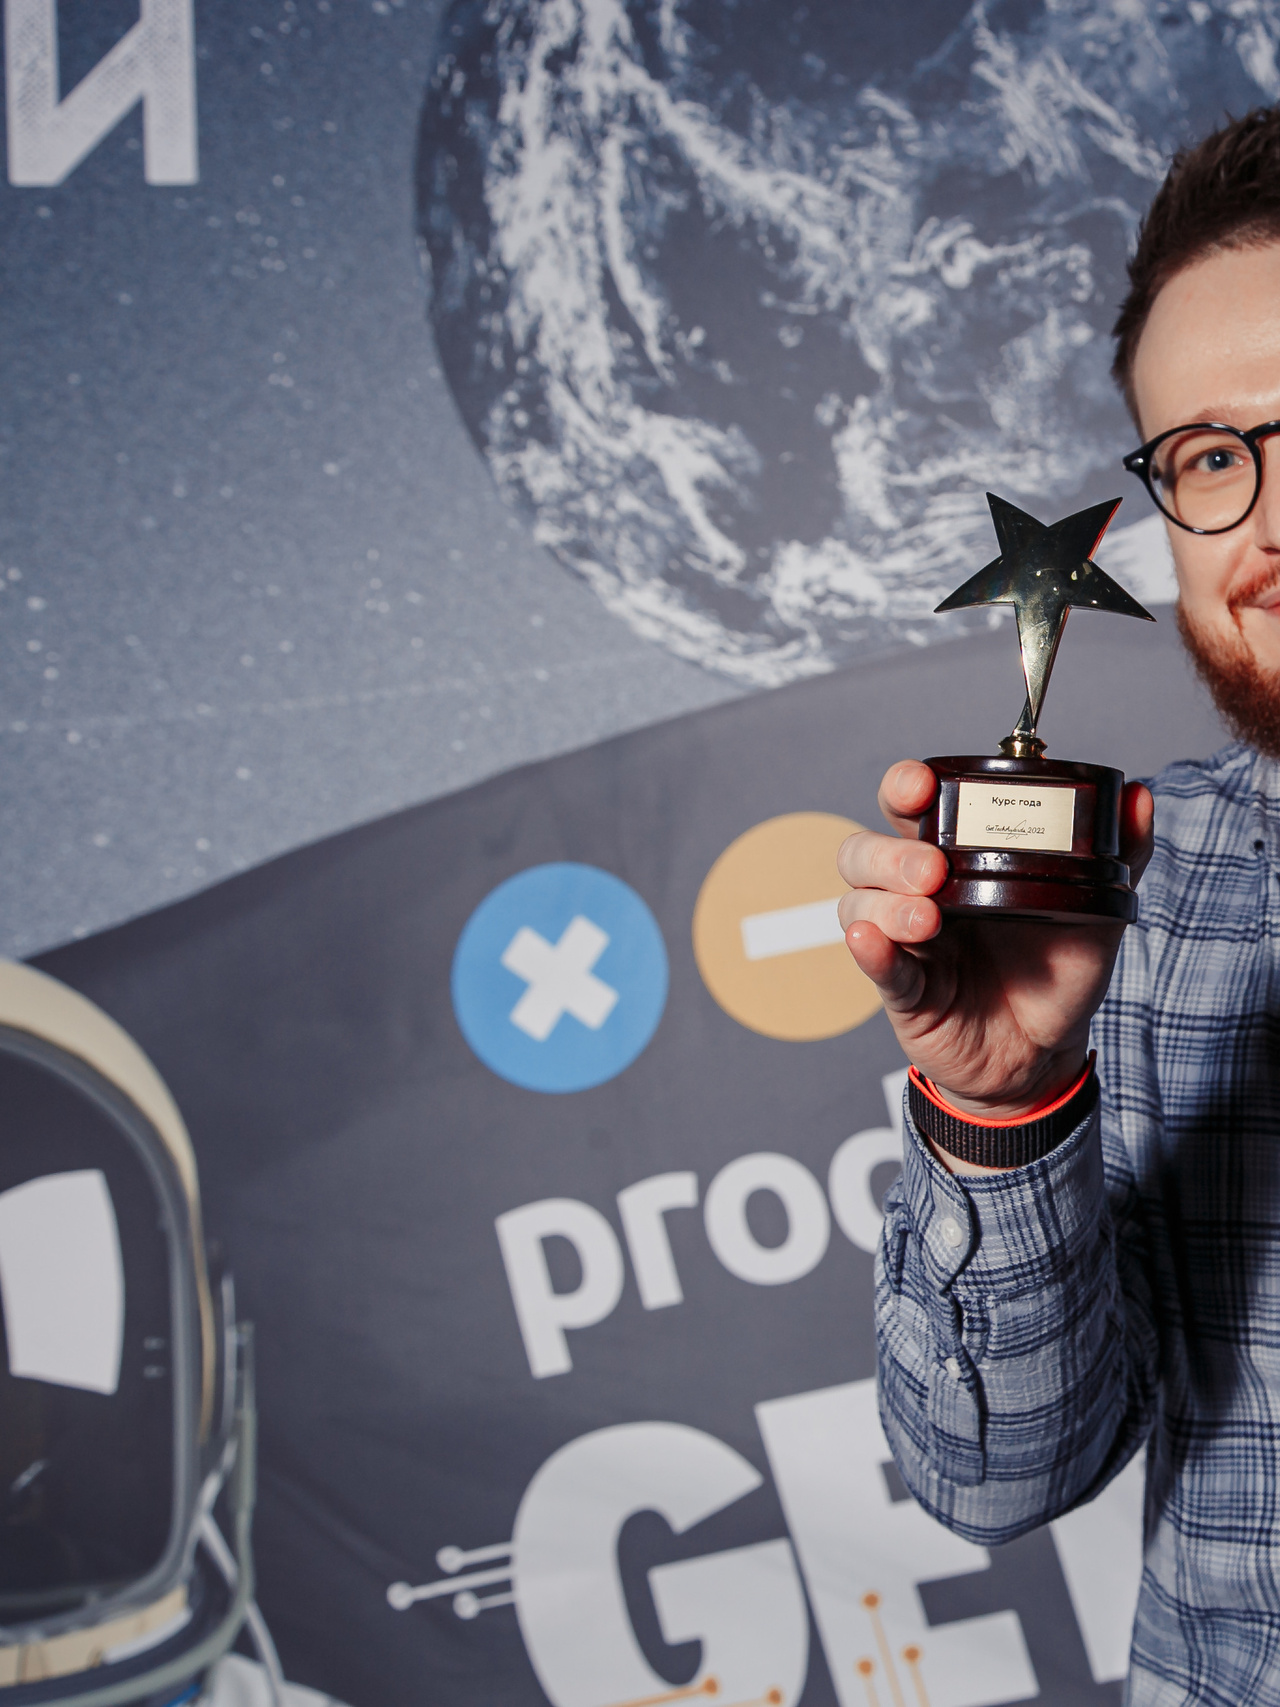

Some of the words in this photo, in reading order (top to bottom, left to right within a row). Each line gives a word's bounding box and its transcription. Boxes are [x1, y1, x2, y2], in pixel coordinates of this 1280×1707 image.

[991, 796, 1016, 806] Курс
[1019, 799, 1042, 807] года
[1027, 826, 1045, 835] 2022
